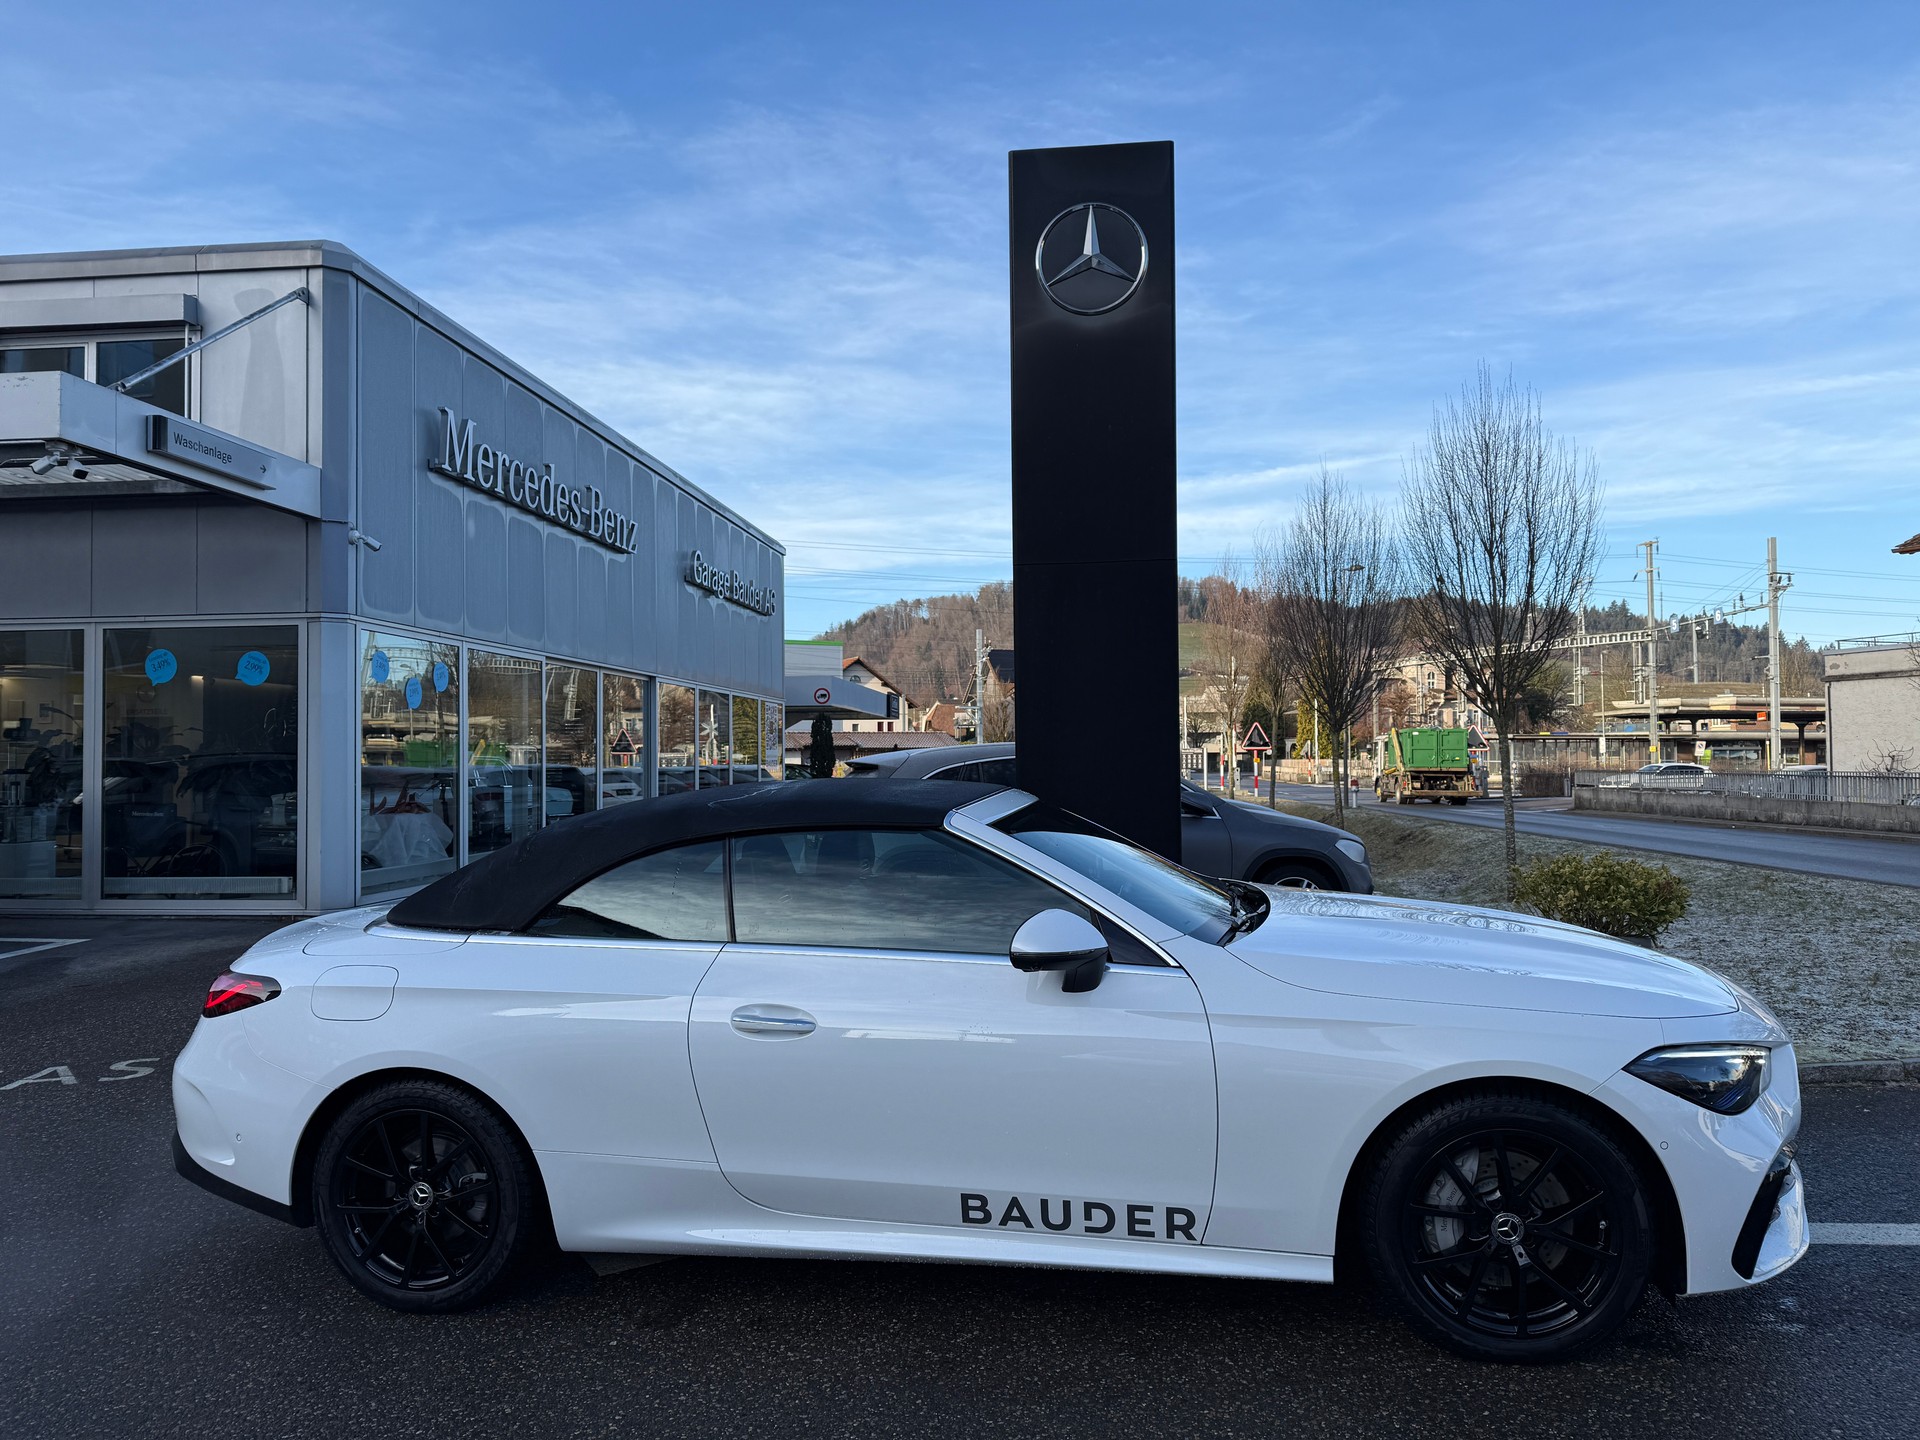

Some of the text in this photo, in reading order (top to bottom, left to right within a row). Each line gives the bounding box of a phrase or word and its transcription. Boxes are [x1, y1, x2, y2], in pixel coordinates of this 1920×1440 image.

[174, 432, 232, 464] Waschanlage
[438, 405, 638, 554] Mercedes-Benz
[694, 550, 776, 616] Garage Bauder AG
[1672, 619, 1677, 631] 5
[1716, 609, 1721, 622] 6
[960, 1192, 1197, 1241] BAUDER
